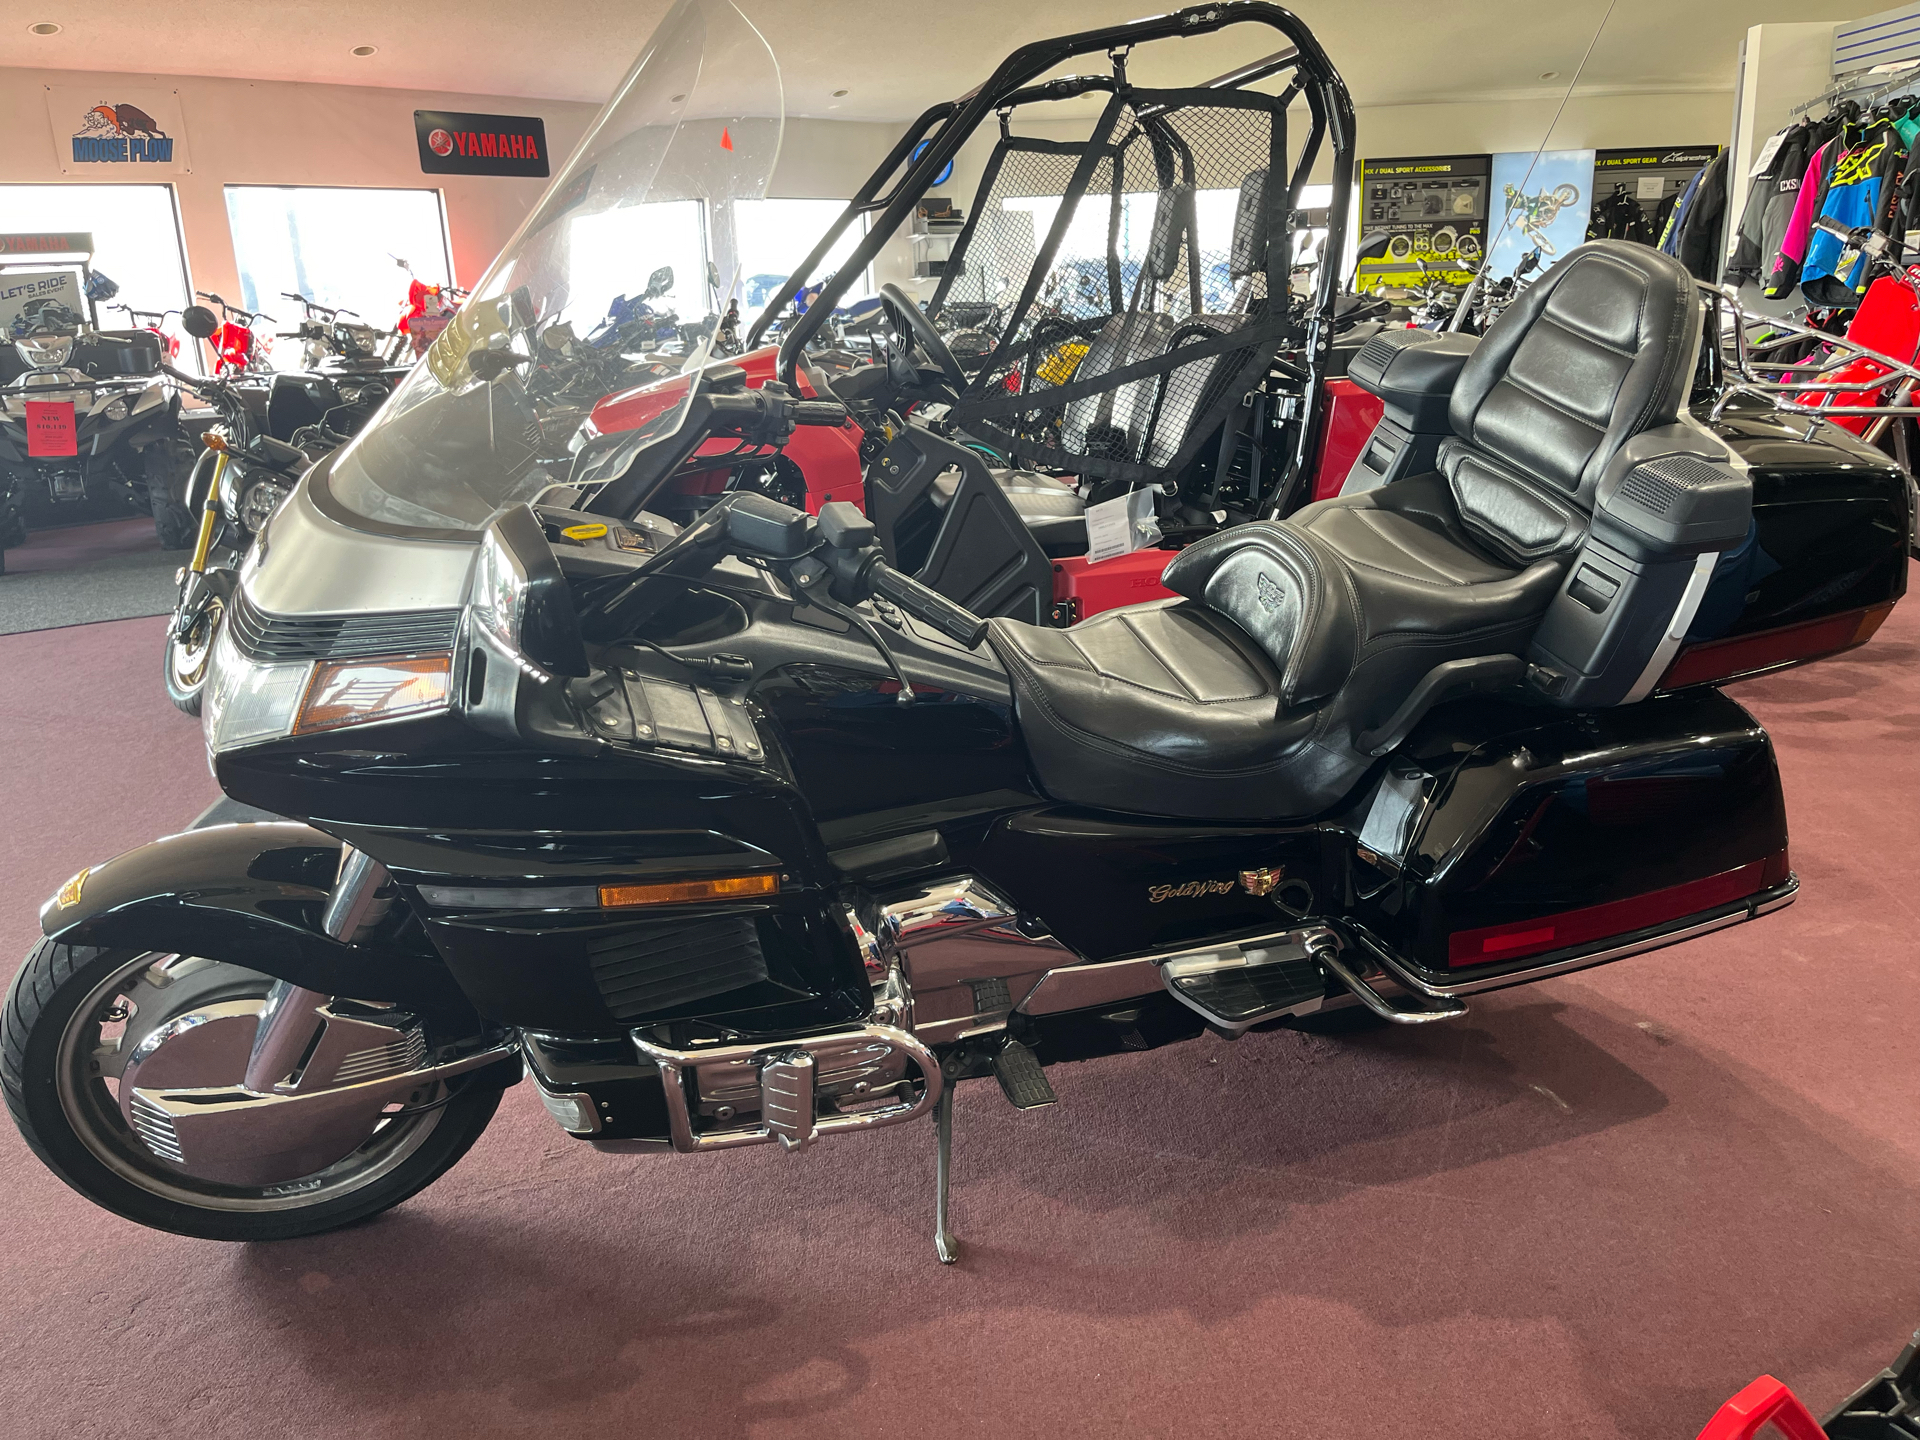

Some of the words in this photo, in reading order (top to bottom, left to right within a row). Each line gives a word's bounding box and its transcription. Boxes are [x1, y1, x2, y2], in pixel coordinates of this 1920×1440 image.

[72, 137, 129, 162] MOOSE
[130, 137, 173, 162] PLOW
[453, 131, 539, 159] YAMAHA
[1395, 166, 1414, 174] SPORT
[1414, 165, 1451, 173] ACCESSORIES
[5, 236, 70, 251] YAMAHA
[1, 283, 36, 300] LET'S
[38, 275, 68, 291] RIDE
[28, 290, 46, 299] SALES
[46, 285, 65, 294] EVENT
